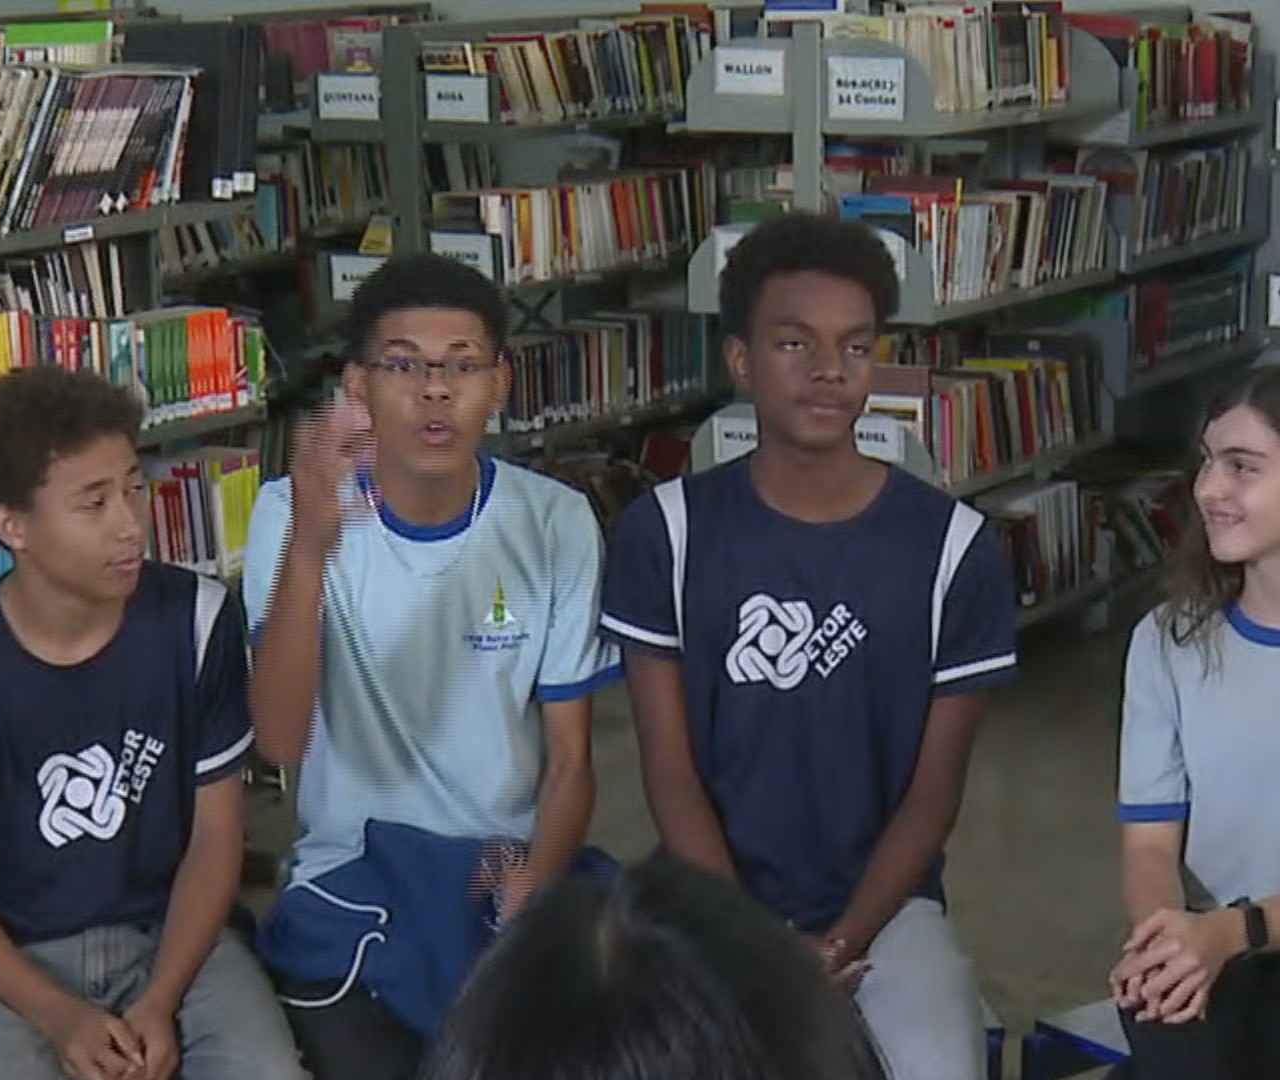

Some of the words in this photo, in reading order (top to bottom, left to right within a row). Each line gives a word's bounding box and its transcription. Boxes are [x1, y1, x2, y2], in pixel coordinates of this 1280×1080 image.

[724, 63, 772, 75] WALLON
[323, 92, 375, 104] QUINTANA
[815, 618, 868, 678] LESTE
[129, 735, 166, 804] LESTE
